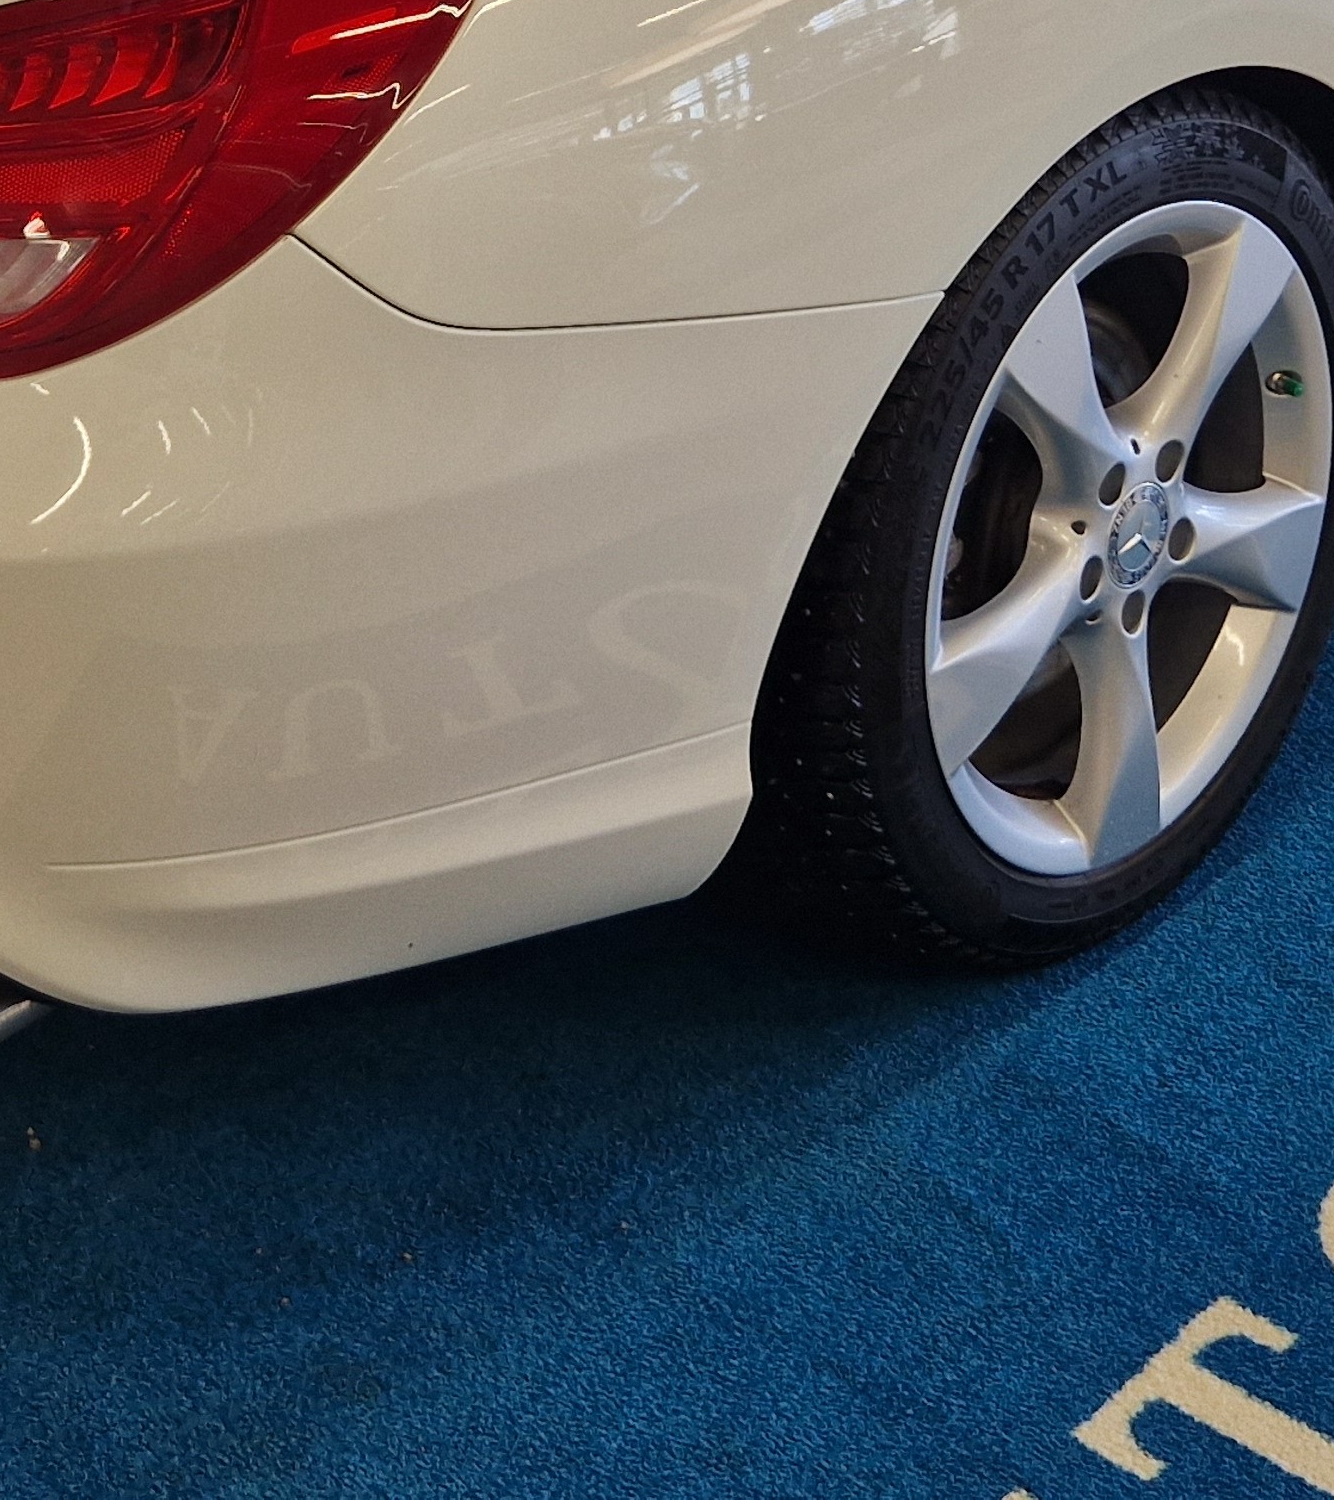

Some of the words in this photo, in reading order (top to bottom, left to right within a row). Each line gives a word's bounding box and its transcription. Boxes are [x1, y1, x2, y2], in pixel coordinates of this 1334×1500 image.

[1001, 254, 1030, 291] R
[1025, 211, 1056, 257] 17
[1059, 187, 1082, 218] T
[1082, 159, 1129, 203] XL
